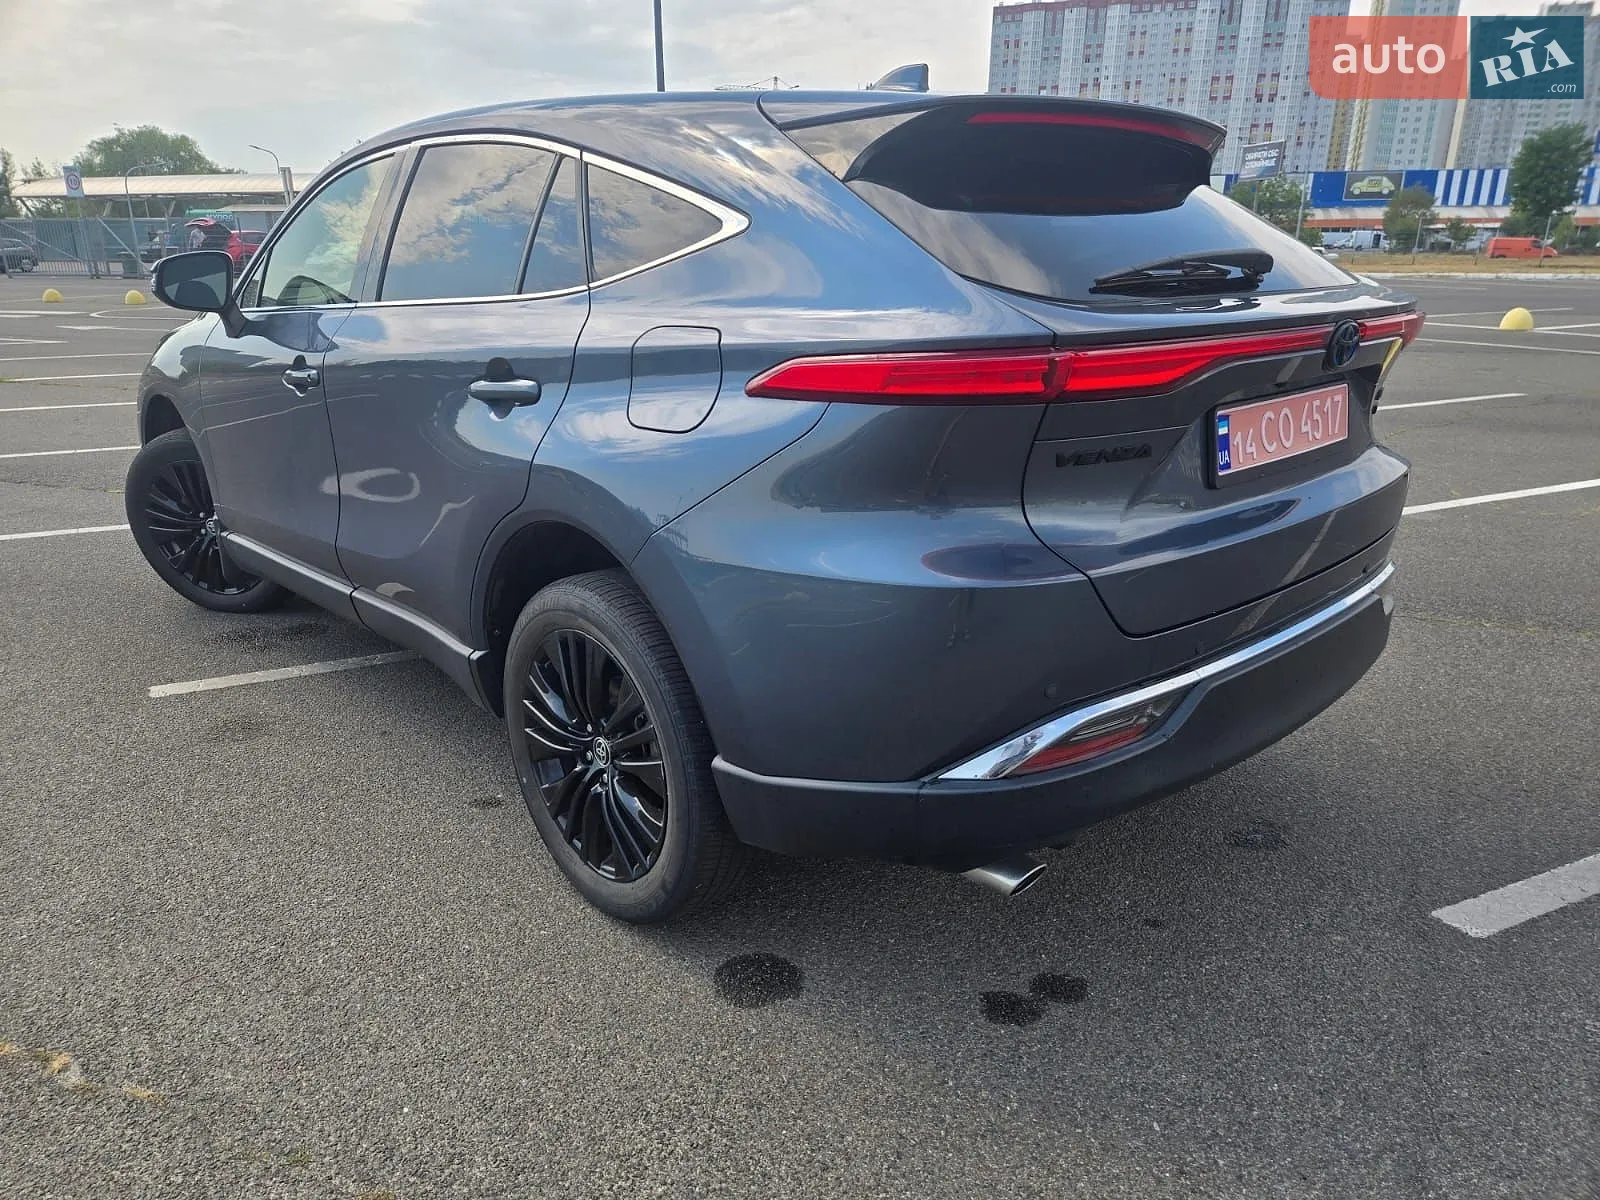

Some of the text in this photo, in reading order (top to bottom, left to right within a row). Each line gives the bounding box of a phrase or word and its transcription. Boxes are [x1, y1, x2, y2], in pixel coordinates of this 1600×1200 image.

[1233, 394, 1343, 464] 14 CO 4517
[1218, 449, 1231, 466] UA
